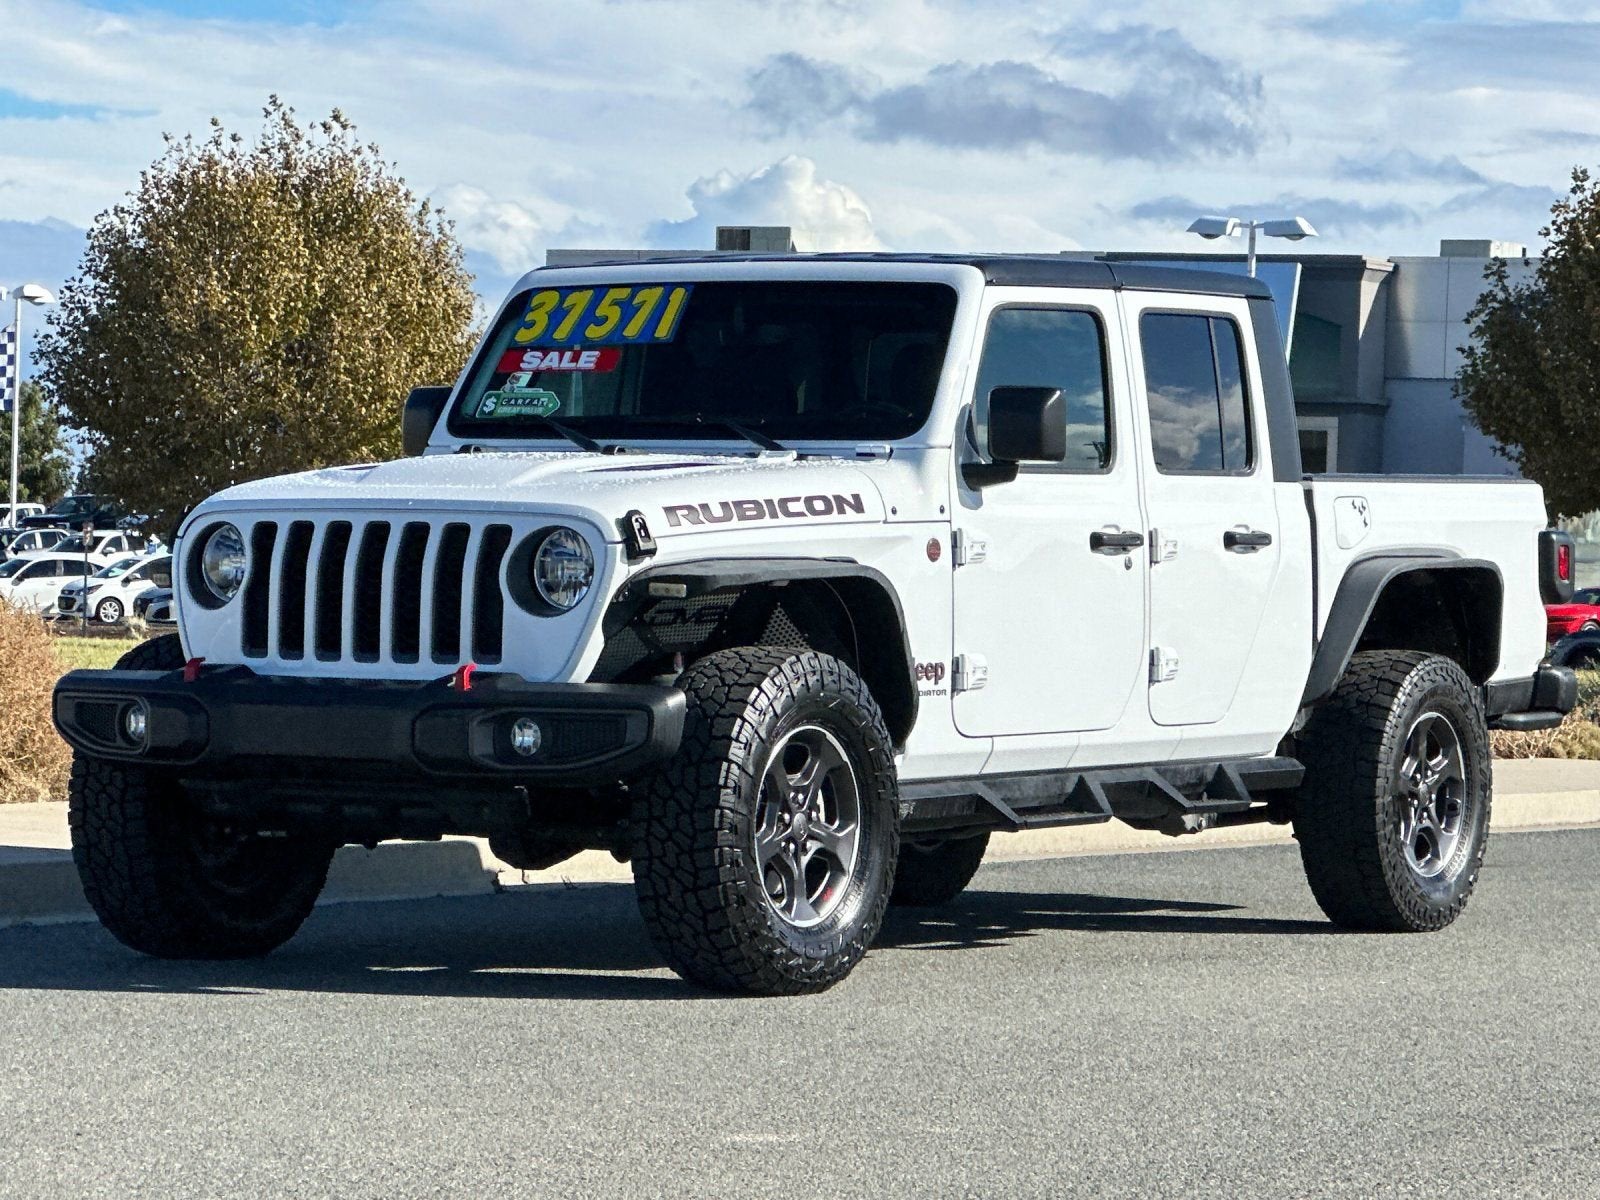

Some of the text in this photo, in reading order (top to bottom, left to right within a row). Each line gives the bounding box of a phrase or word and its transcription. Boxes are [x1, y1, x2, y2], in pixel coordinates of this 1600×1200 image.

[520, 351, 600, 370] SALE
[662, 493, 866, 527] RUBICON
[914, 662, 945, 685] eep
[918, 689, 947, 697] DIATOR
